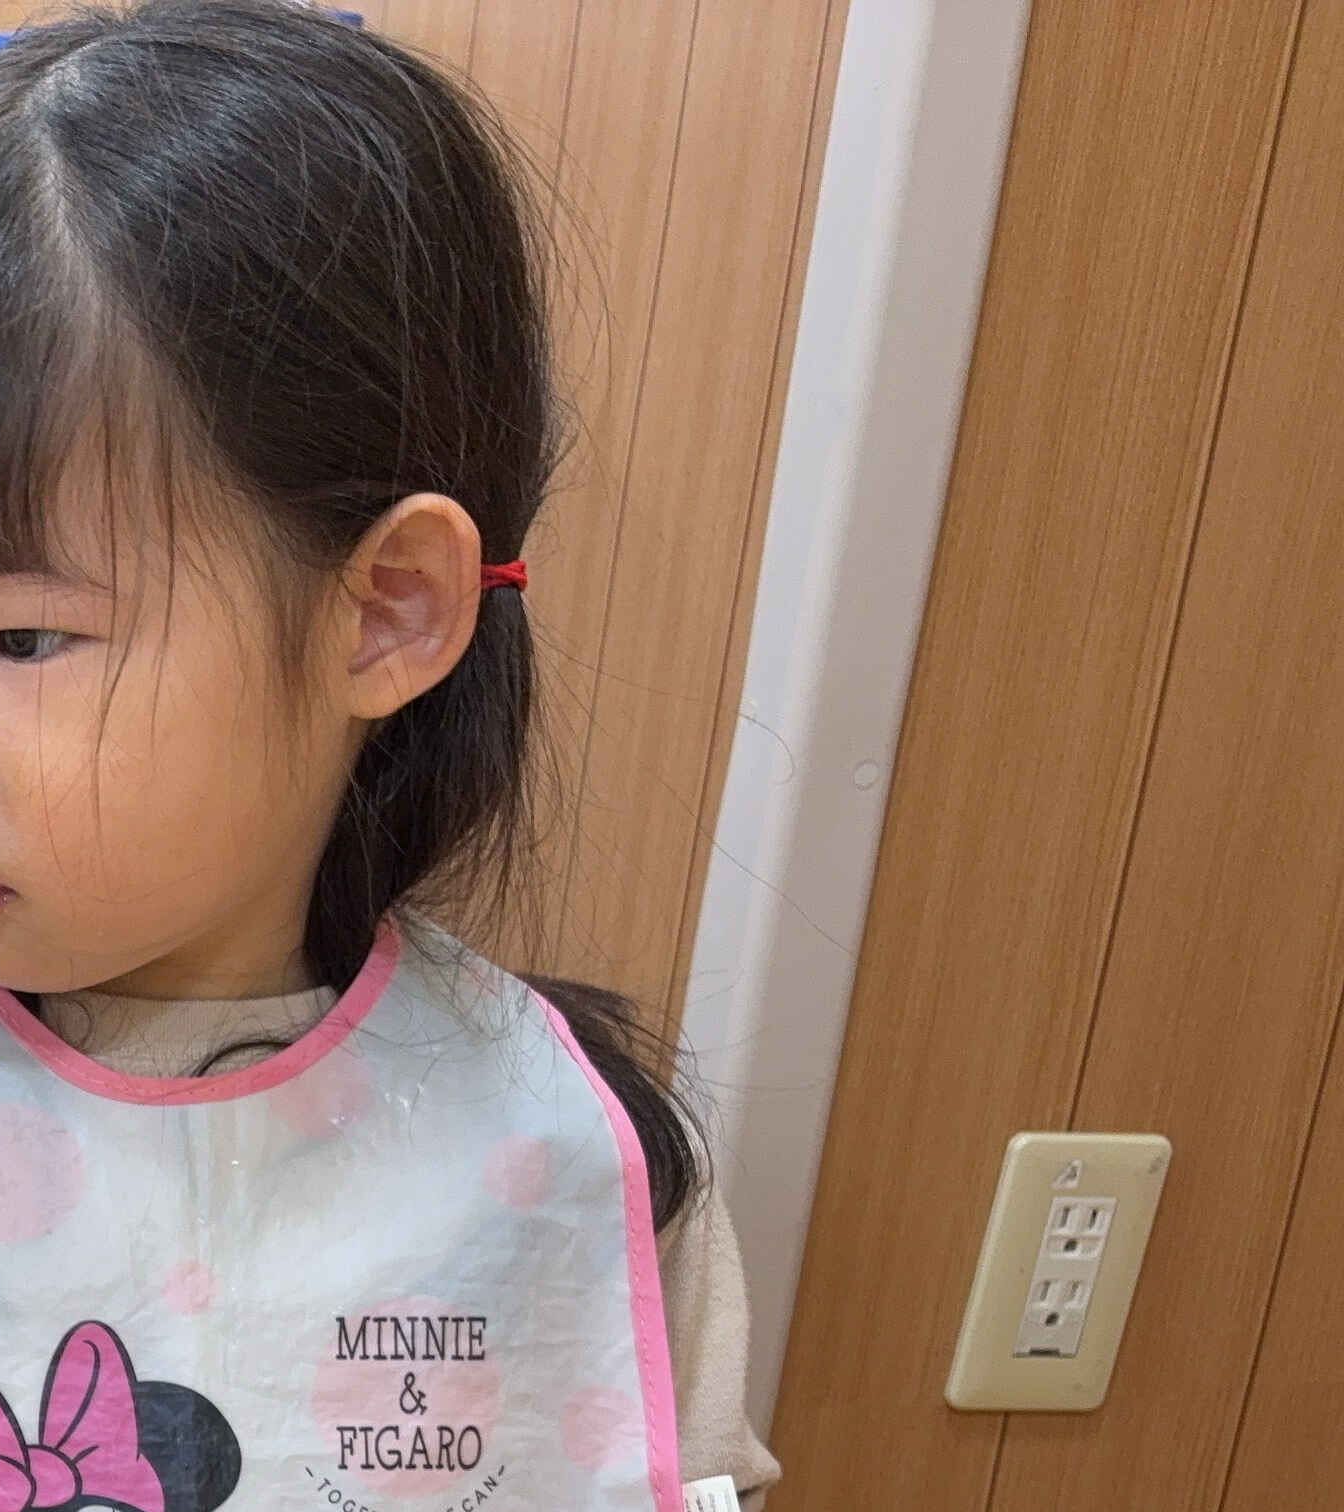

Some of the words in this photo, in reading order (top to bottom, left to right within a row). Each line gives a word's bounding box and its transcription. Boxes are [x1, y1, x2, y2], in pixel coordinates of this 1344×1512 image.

[335, 1316, 487, 1360] MINNIE
[399, 1372, 428, 1416] &
[336, 1425, 482, 1472] FIGARO
[462, 1475, 499, 1512] CAN
